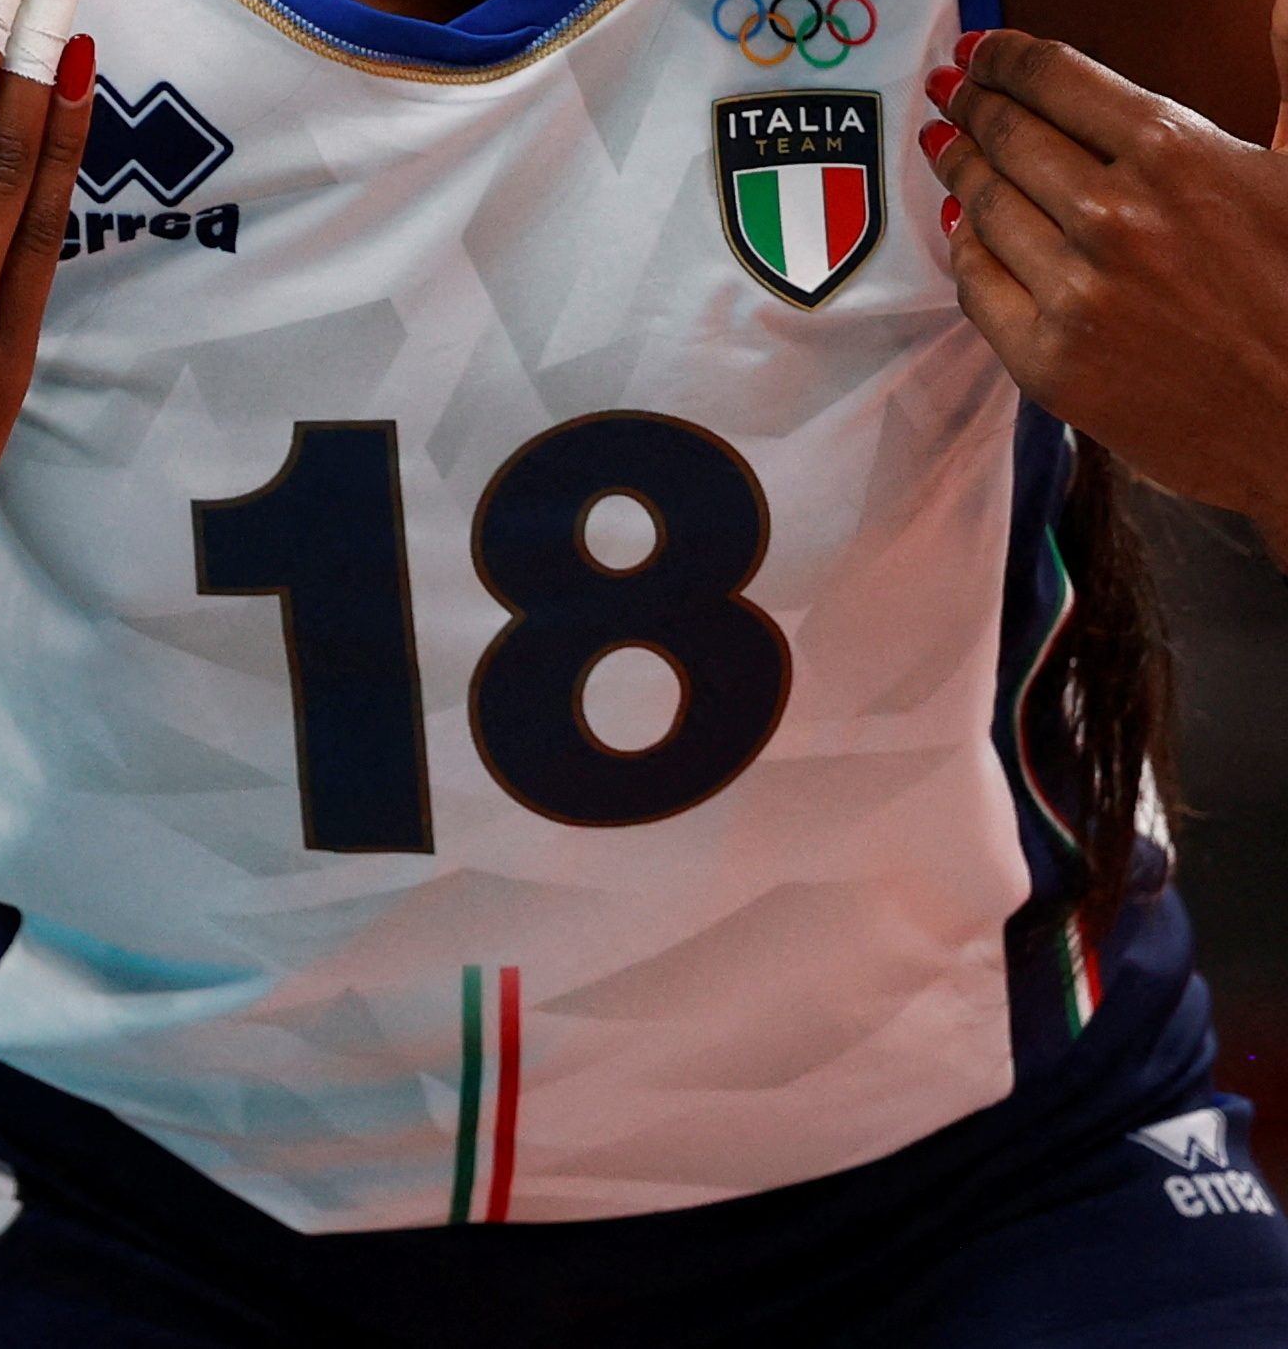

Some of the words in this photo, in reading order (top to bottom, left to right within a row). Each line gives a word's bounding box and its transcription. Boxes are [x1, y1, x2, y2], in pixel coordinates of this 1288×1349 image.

[728, 106, 865, 139] ITALIA
[755, 136, 843, 156] TEAM
[191, 409, 793, 854] 18
